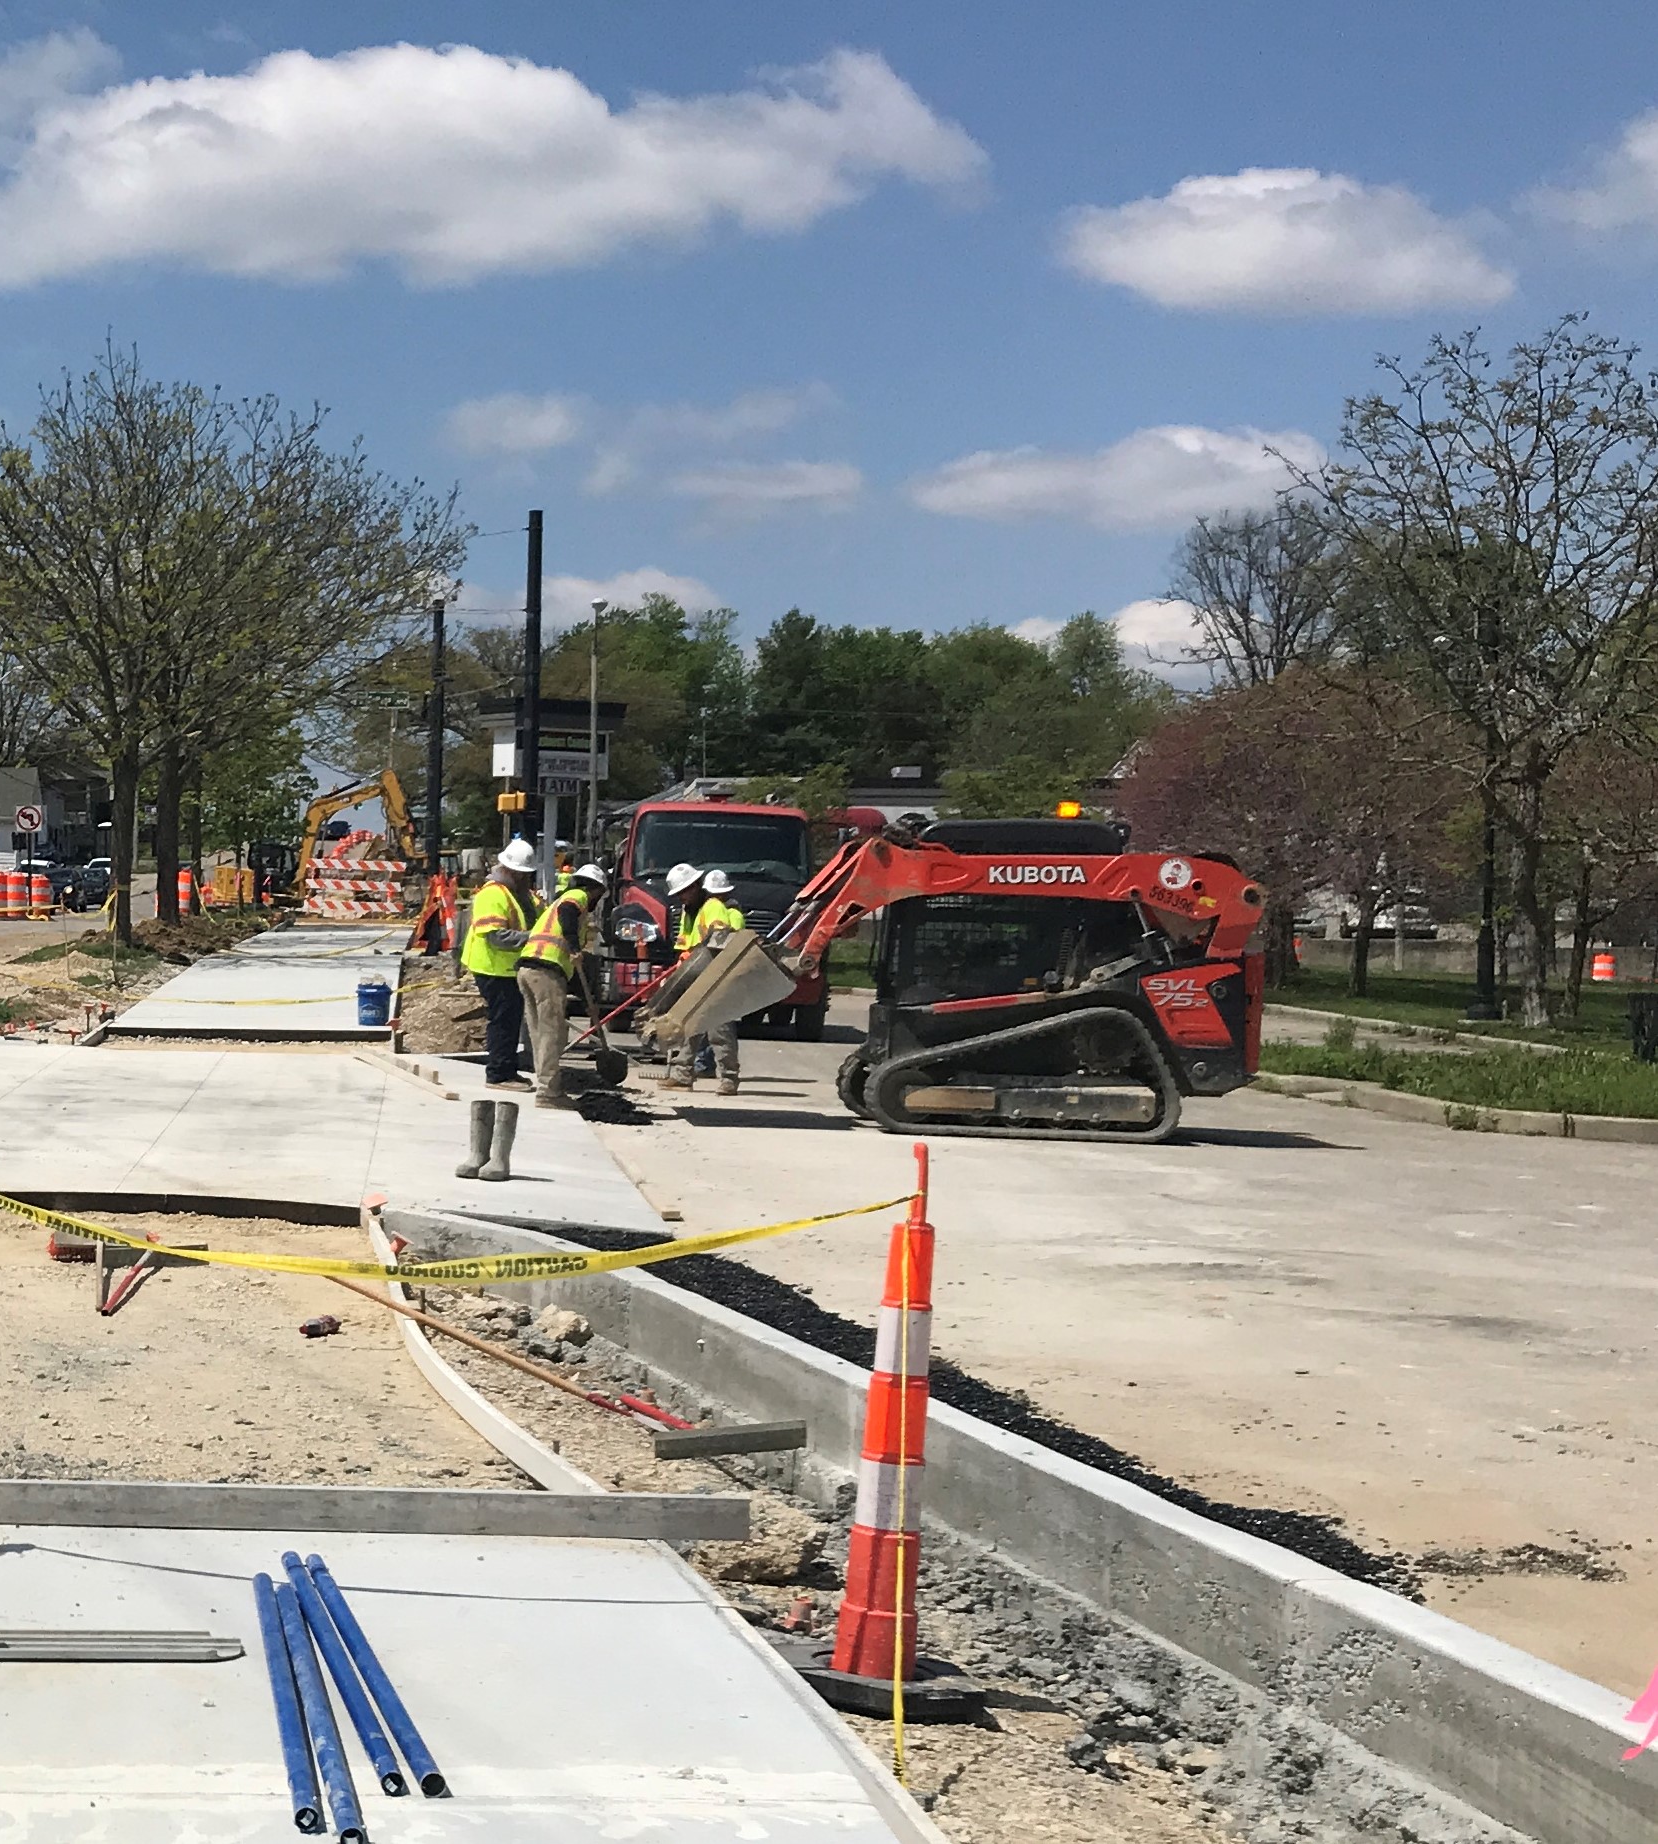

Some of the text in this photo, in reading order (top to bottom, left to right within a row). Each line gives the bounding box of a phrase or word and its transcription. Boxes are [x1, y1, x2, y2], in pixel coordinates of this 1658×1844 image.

[548, 778, 579, 793] ATM
[988, 865, 1086, 884] KUBOTA
[1146, 979, 1204, 991] SVL
